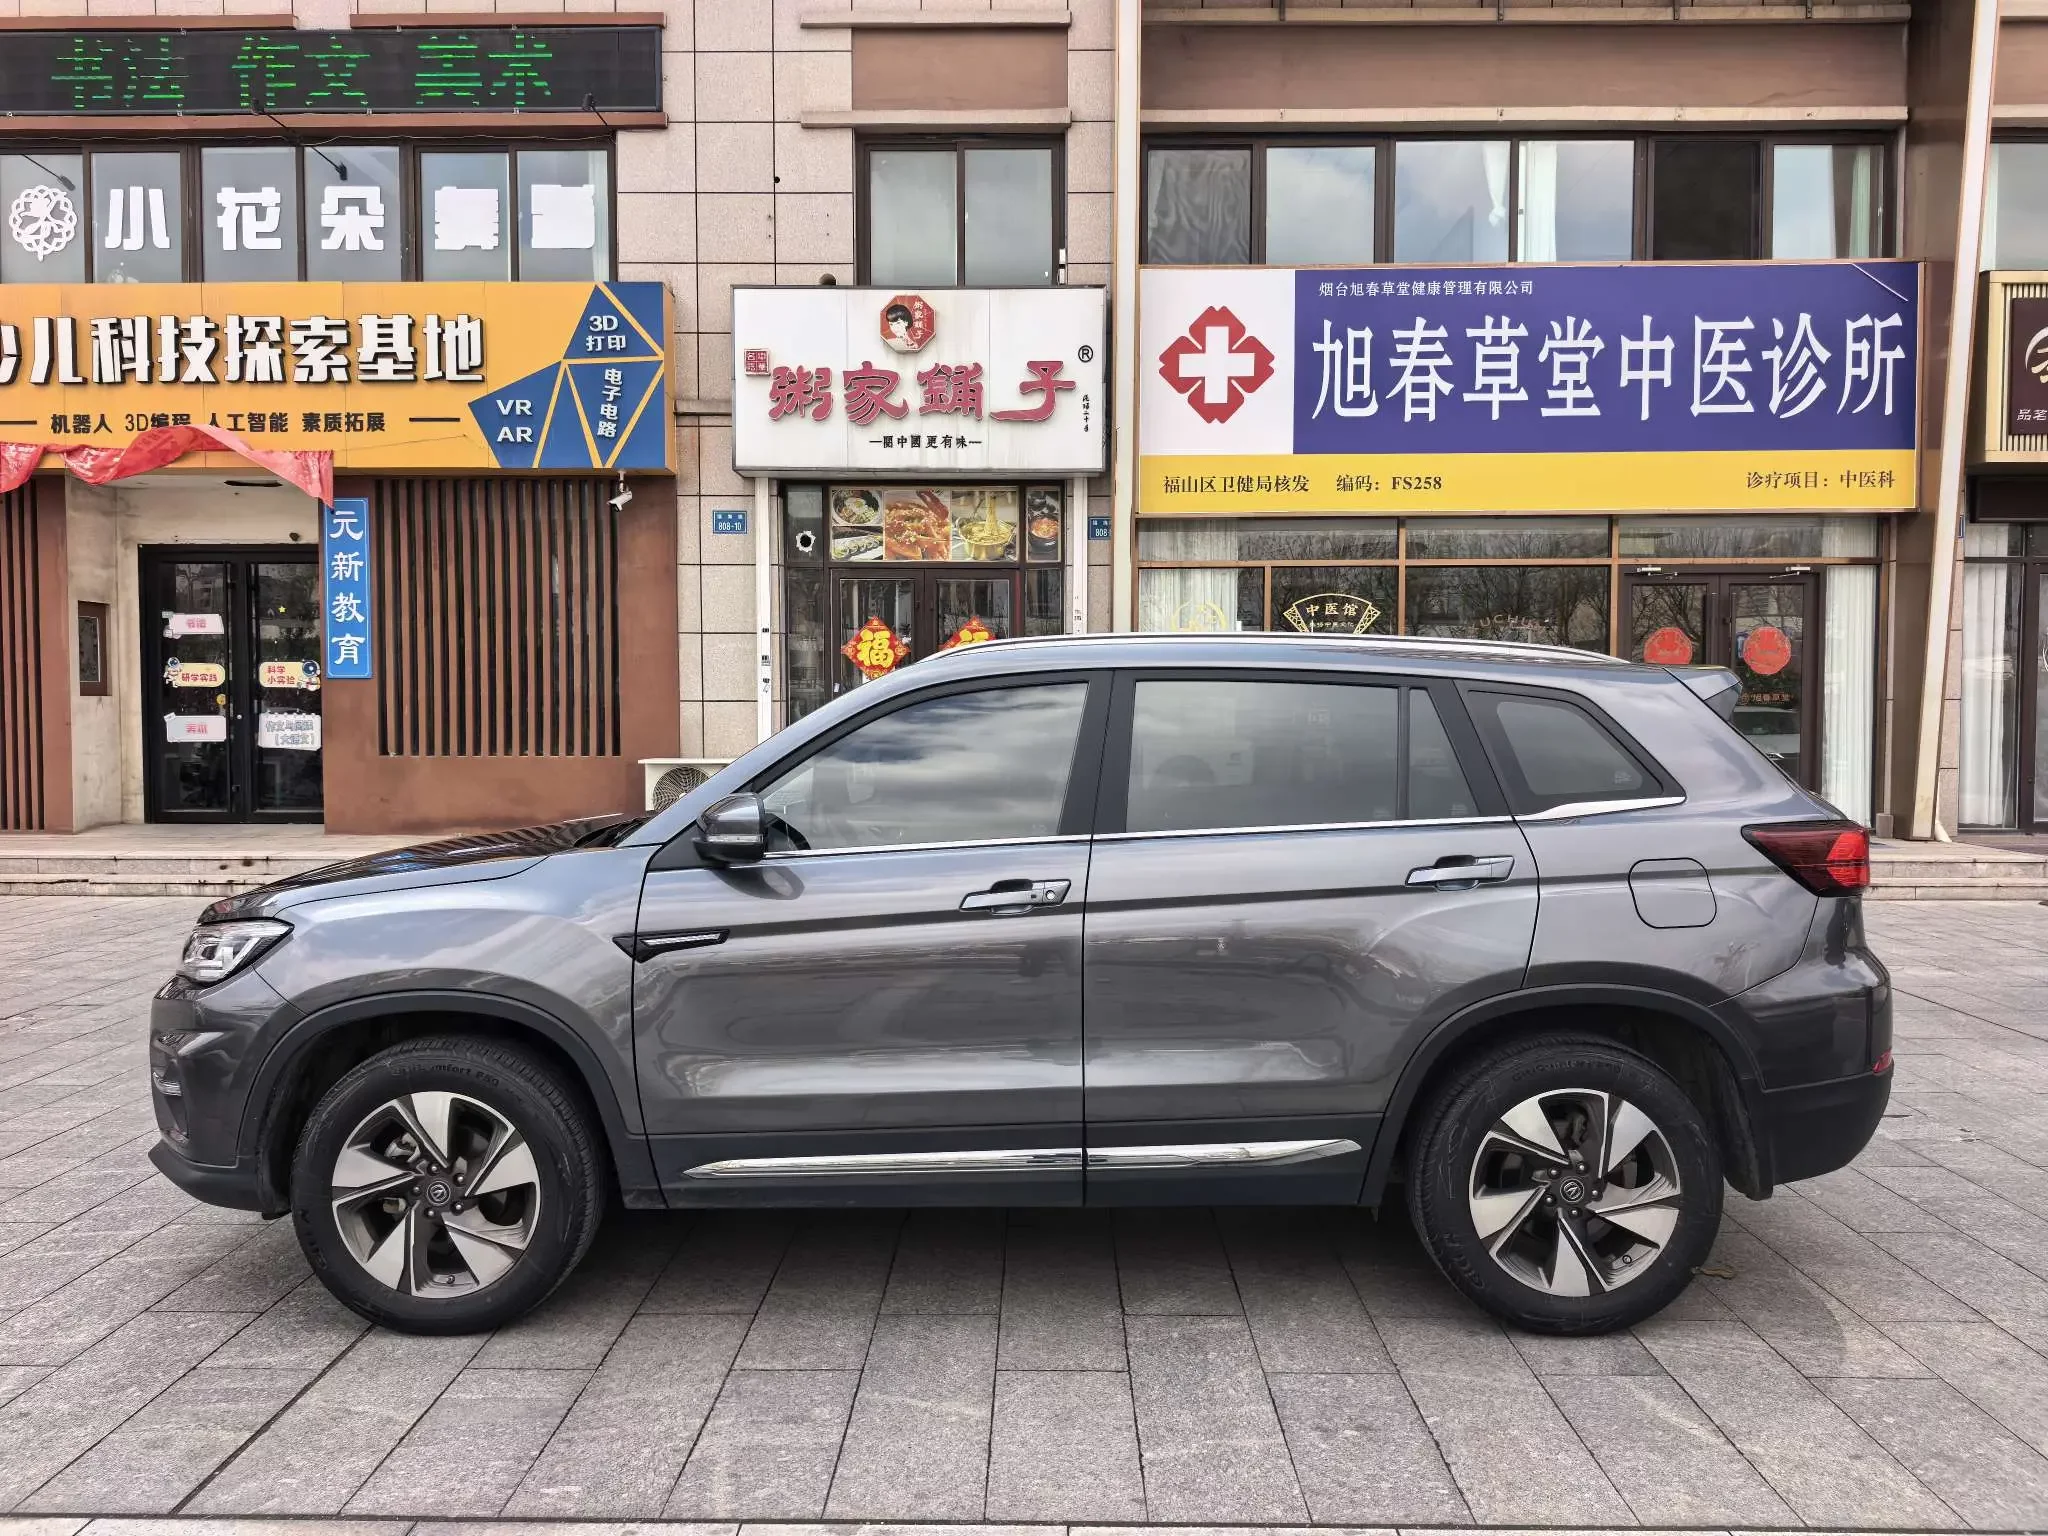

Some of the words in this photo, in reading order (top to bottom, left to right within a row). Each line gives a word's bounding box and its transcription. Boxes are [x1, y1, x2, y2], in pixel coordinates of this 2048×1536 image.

[232, 35, 370, 107] 作文
[414, 34, 553, 107] 美术
[1319, 280, 1534, 297] 烟台旭春草堂健康管理有限公司
[588, 315, 619, 332] 3D
[586, 335, 627, 352] 打印
[1311, 312, 1908, 422] 旭春草堂中医诊所
[496, 399, 533, 416] VR
[597, 368, 622, 438] 电子电路
[50, 413, 113, 434] 机器人
[208, 412, 289, 433] 人工智能
[301, 412, 386, 433] 素质拓展
[497, 426, 533, 443] AR
[1163, 475, 1310, 493] 福山区卫健局核发
[1391, 476, 1443, 490] FS258
[1839, 470, 1896, 489] 中医科
[718, 521, 742, 531] 808-10
[329, 511, 365, 664] 元新教育
[1306, 603, 1358, 617] 中医馆
[857, 629, 894, 669] 福
[267, 665, 286, 674] 科学
